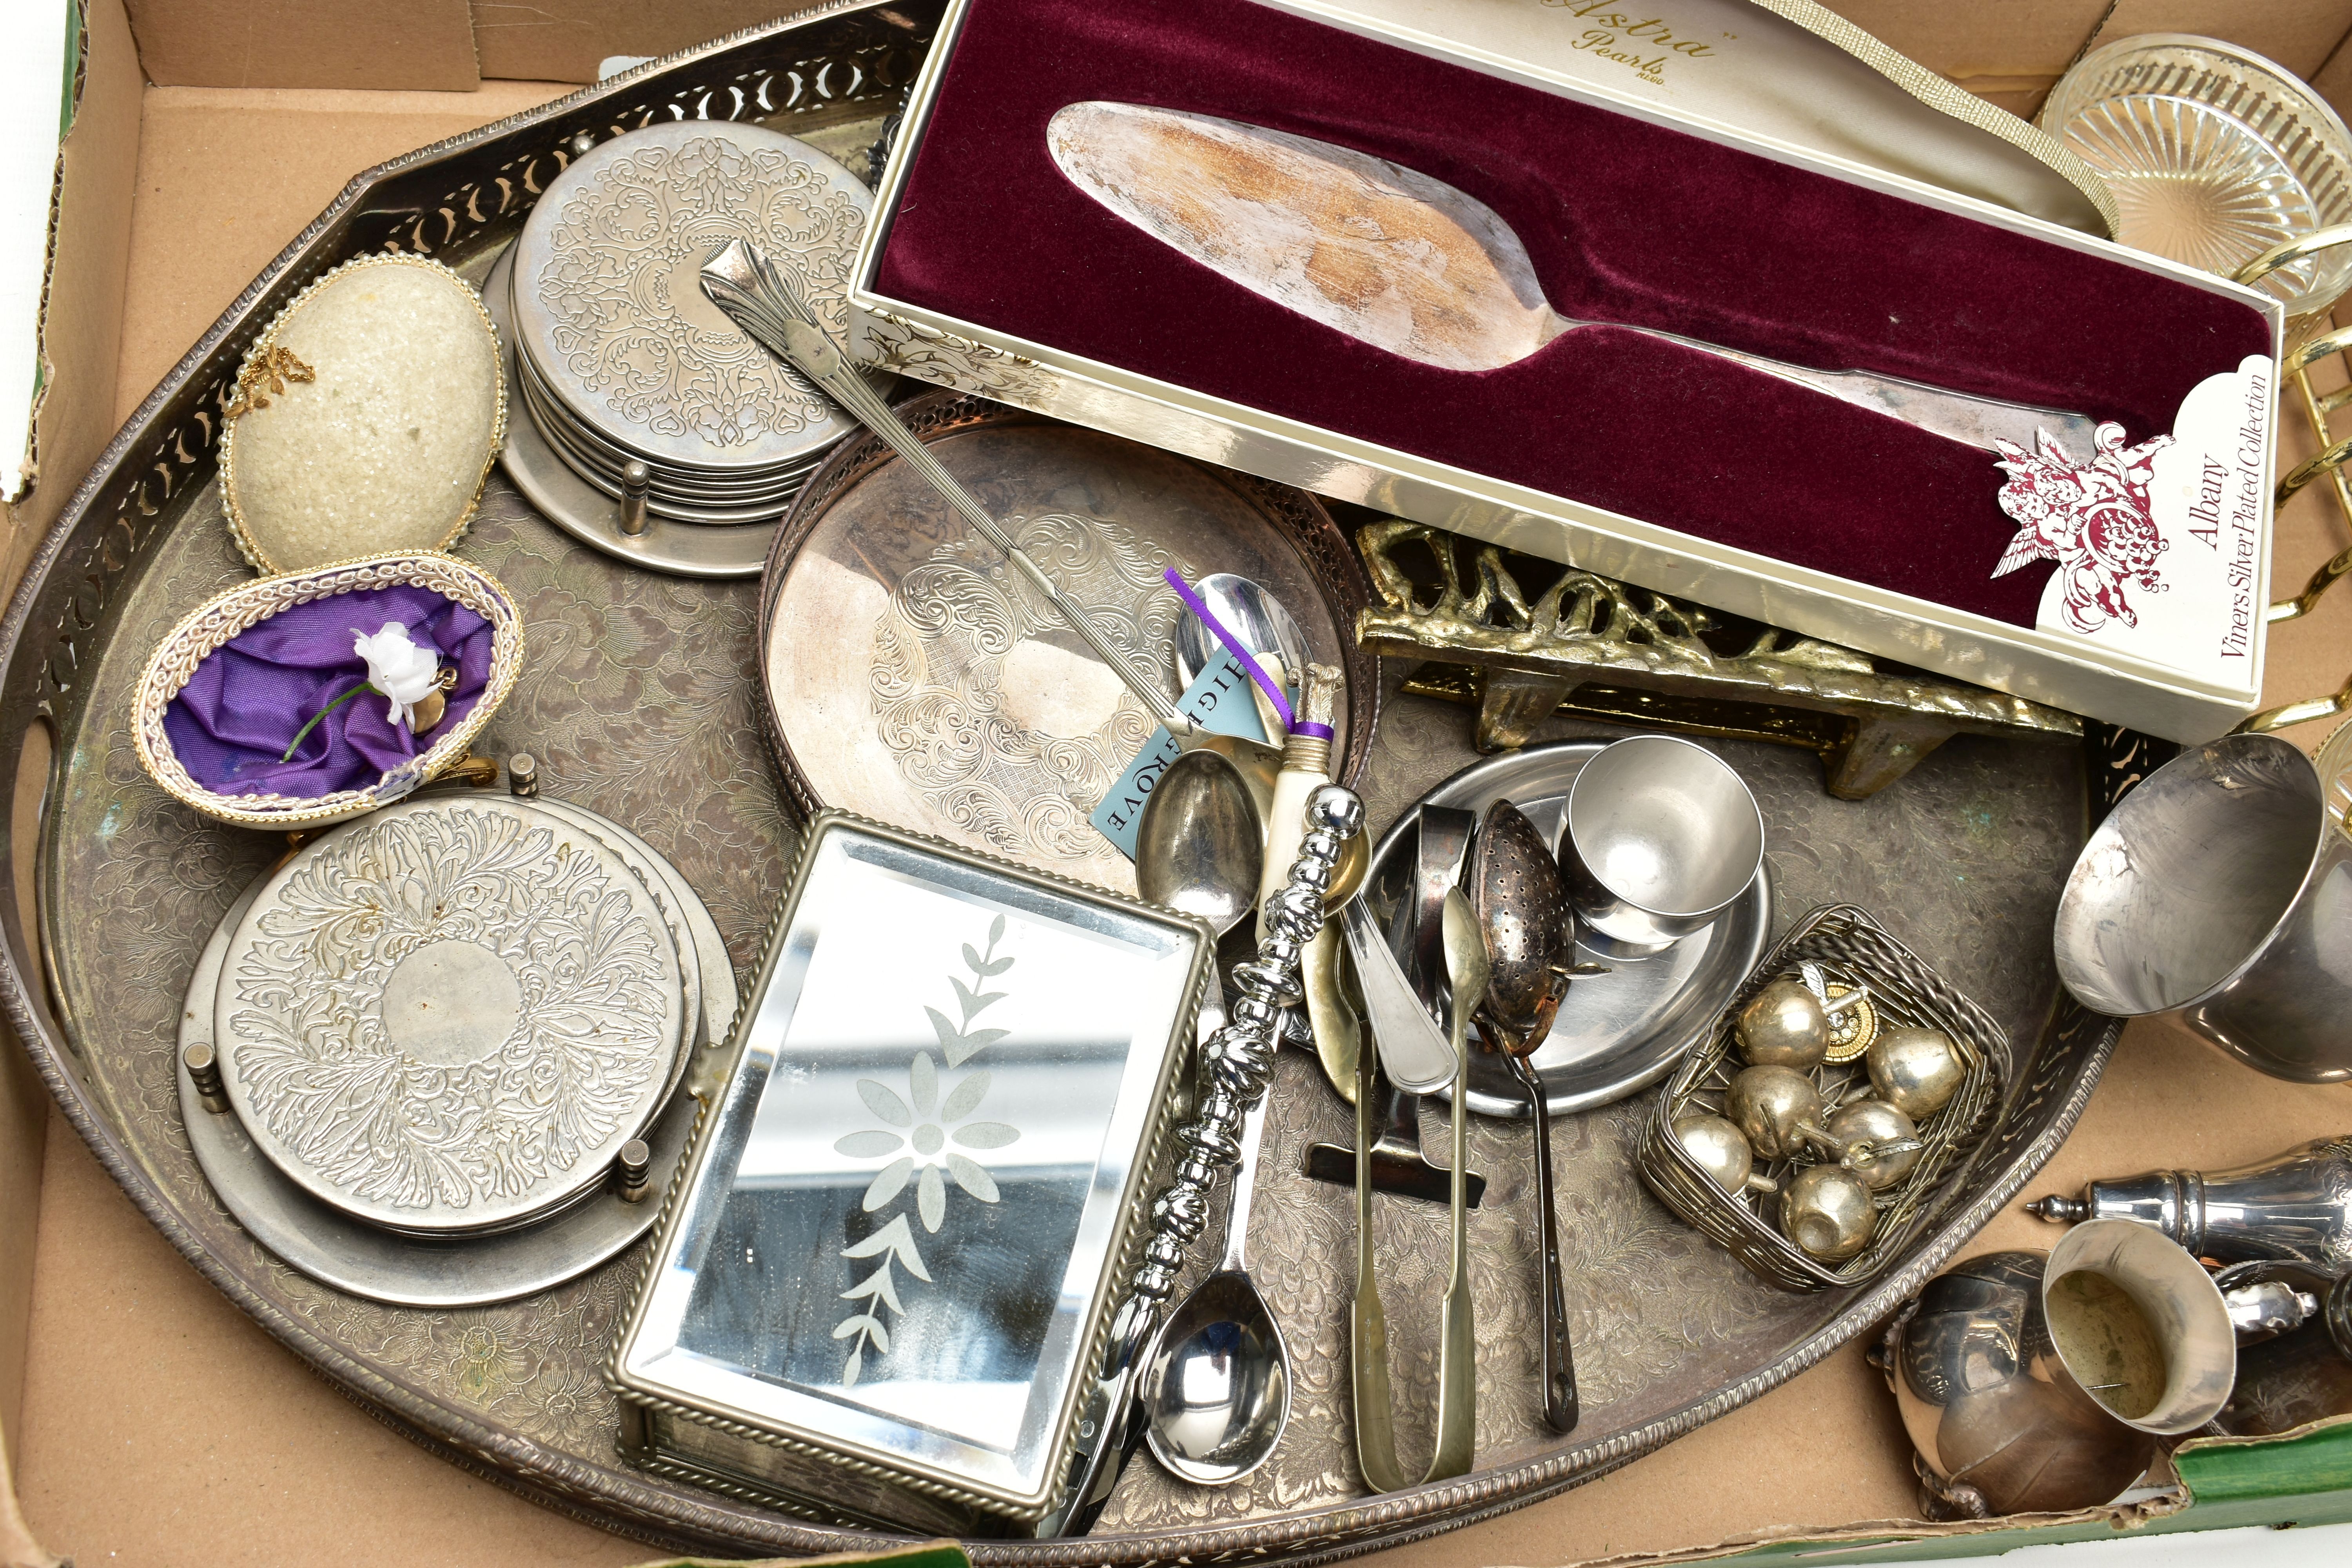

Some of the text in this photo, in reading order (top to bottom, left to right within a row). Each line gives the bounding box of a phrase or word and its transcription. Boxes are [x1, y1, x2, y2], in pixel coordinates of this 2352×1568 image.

[1572, 30, 1667, 74] Pearls
[2187, 453, 2229, 552] Albany
[2221, 374, 2266, 658] Viners Silver Plated Collection
